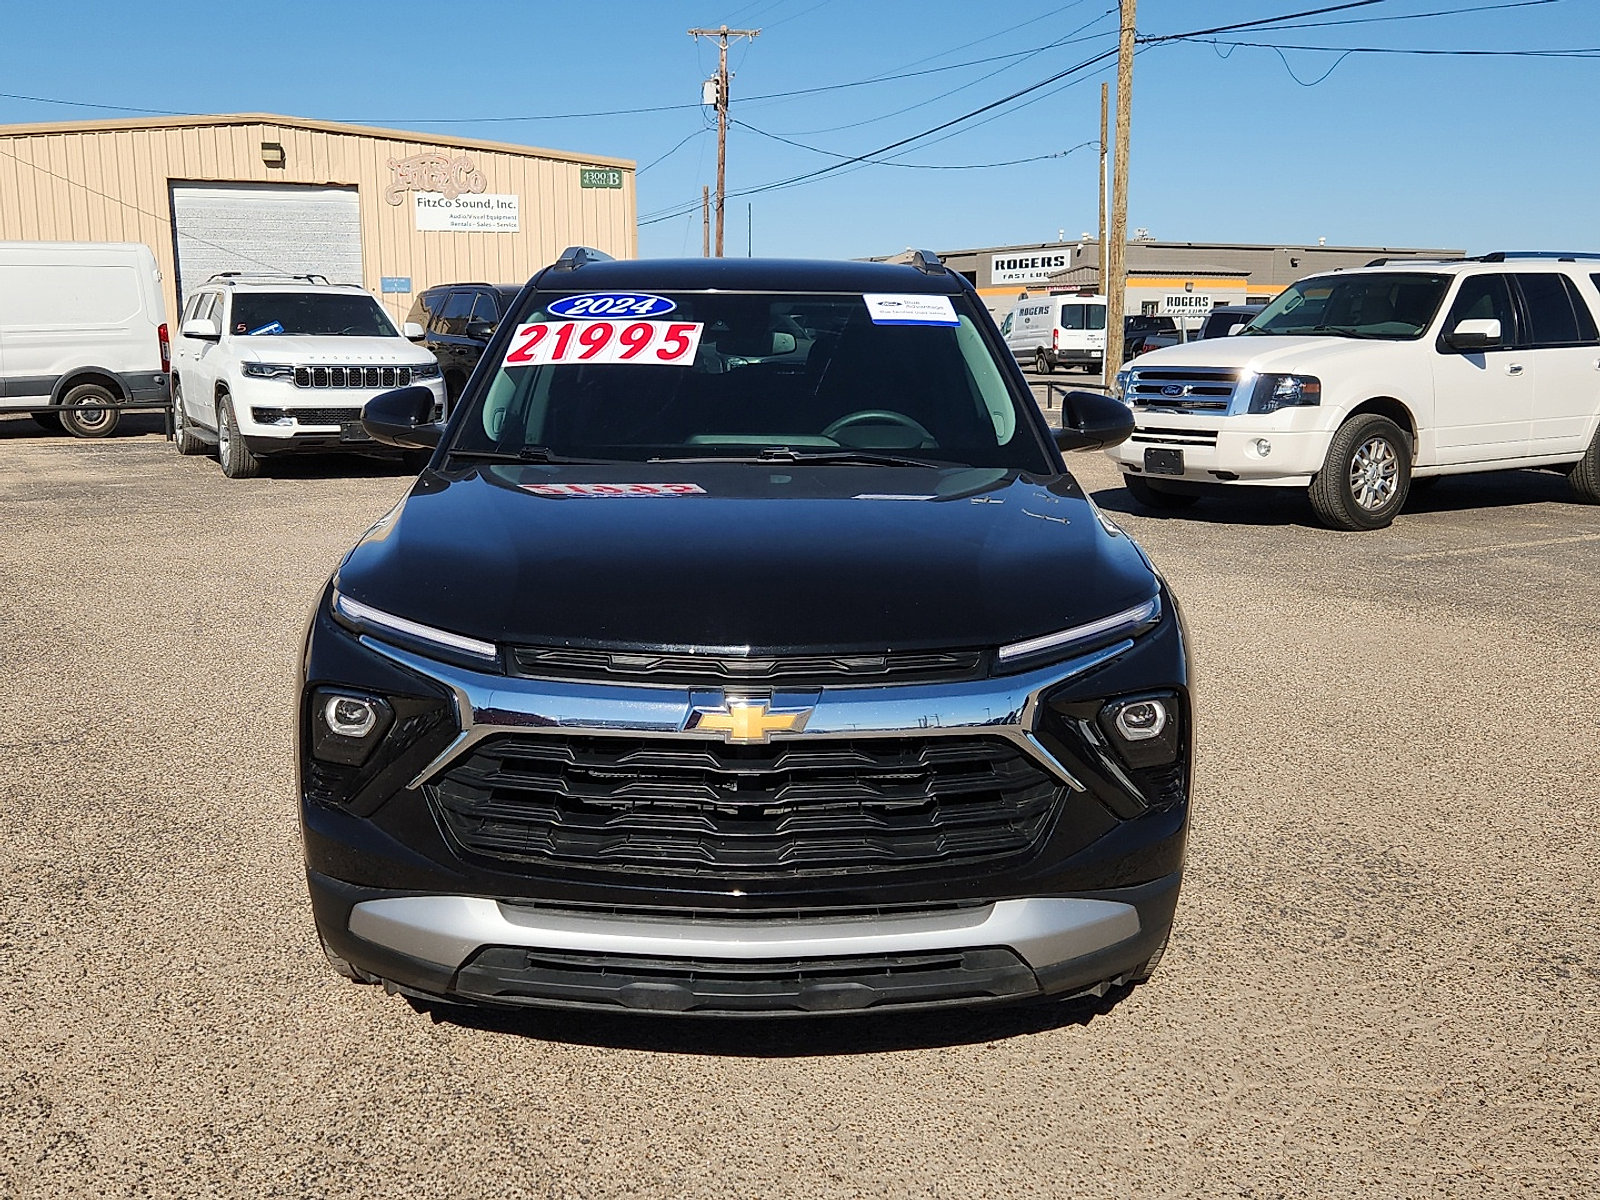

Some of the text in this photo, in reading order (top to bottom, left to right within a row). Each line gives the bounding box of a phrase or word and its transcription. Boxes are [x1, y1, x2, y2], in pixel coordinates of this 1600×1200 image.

[583, 171, 606, 180] 4300
[609, 172, 620, 185] B
[417, 197, 517, 210] FitzCo Sound, Inc.
[995, 255, 1065, 271] ROGERS
[1003, 272, 1026, 280] FAST
[565, 297, 657, 315] 2024
[1166, 296, 1209, 307] ROGERS
[1018, 306, 1050, 317] ROGERS
[507, 322, 698, 363] 21995
